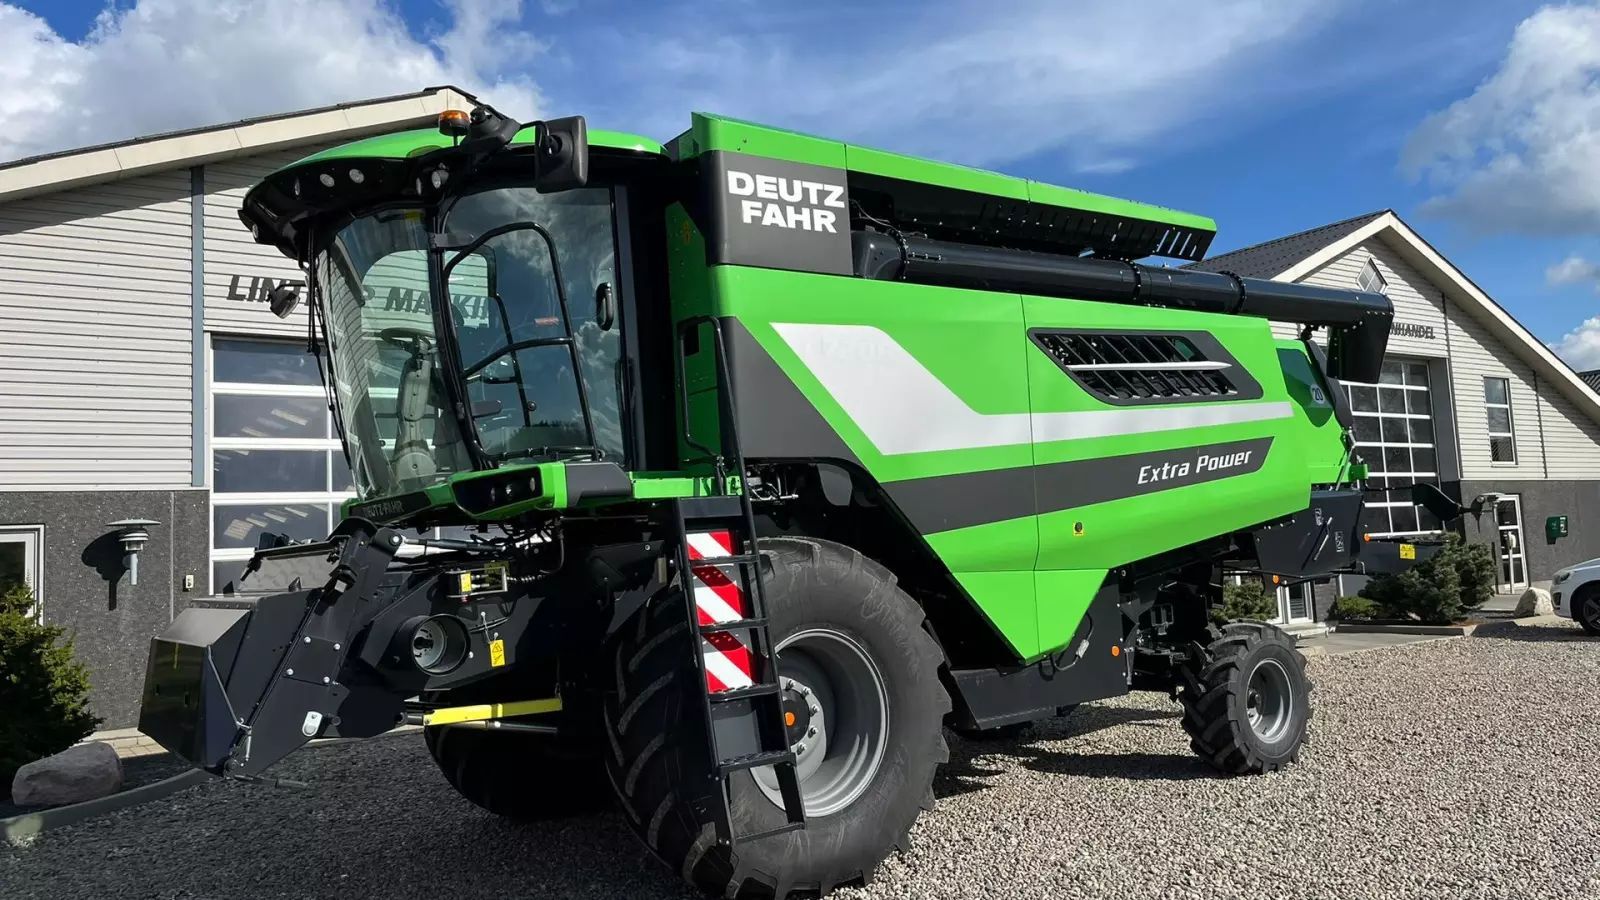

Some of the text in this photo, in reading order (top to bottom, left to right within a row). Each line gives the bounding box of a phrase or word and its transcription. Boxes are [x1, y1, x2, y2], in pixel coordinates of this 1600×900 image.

[727, 170, 845, 208] DEUTZ
[741, 200, 837, 233] FAHR
[384, 286, 489, 319] MAKI
[1312, 387, 1324, 401] 20
[1137, 451, 1252, 485] Extra Power
